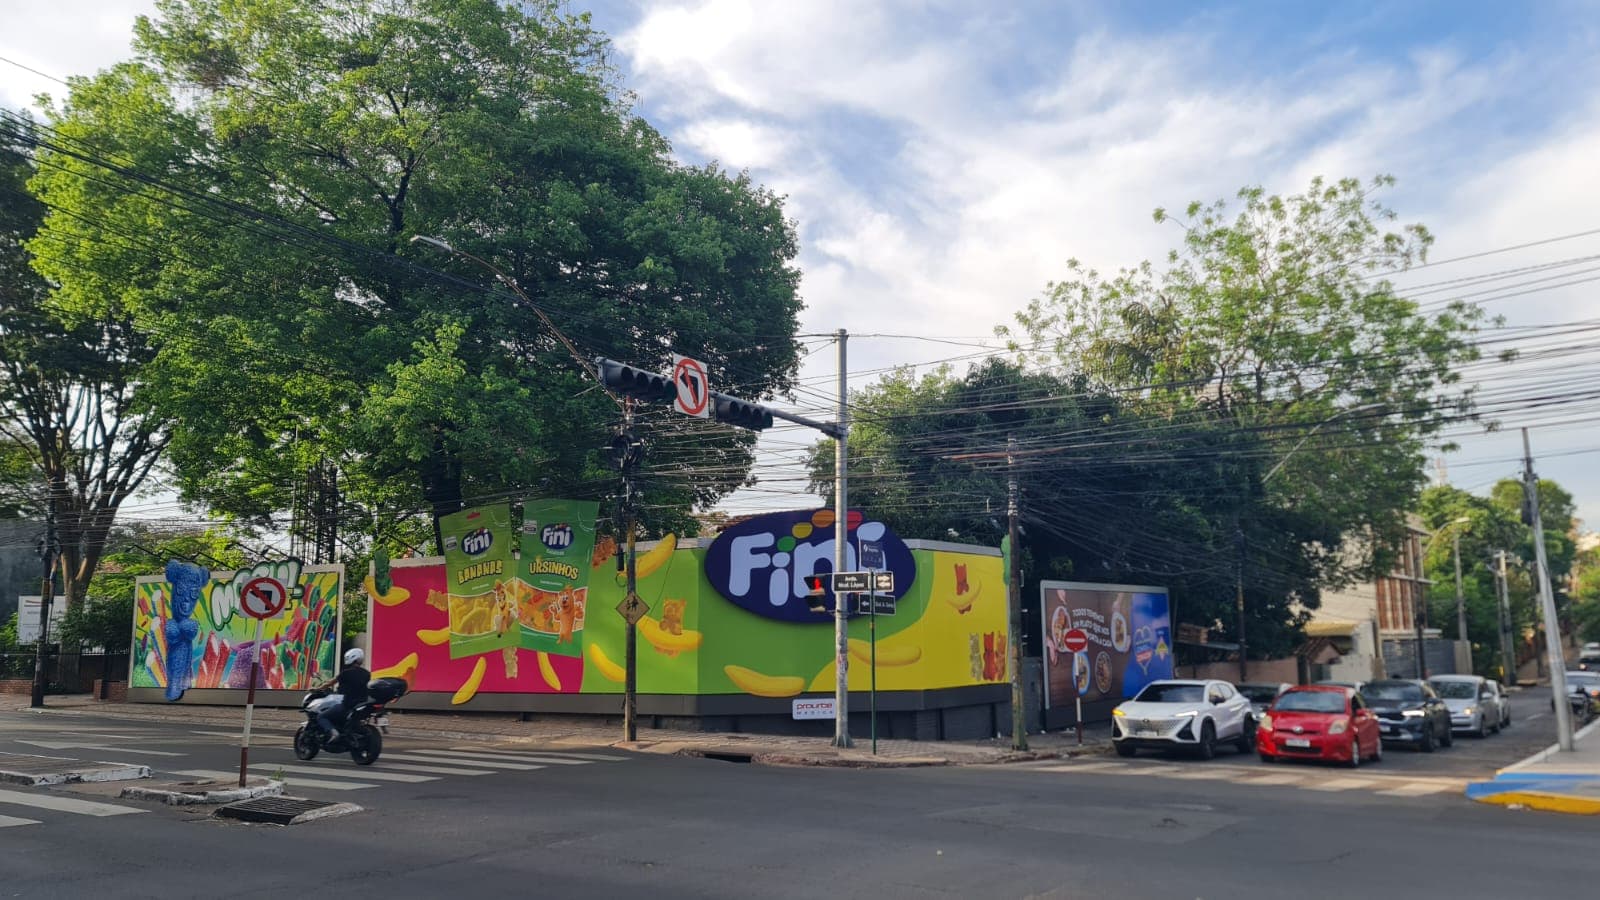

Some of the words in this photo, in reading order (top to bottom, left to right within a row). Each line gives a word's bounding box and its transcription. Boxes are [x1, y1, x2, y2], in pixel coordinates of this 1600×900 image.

[463, 528, 490, 553] Fini
[542, 527, 571, 547] Fini
[457, 559, 503, 584] BANANAS
[529, 557, 579, 581] URSINHOS
